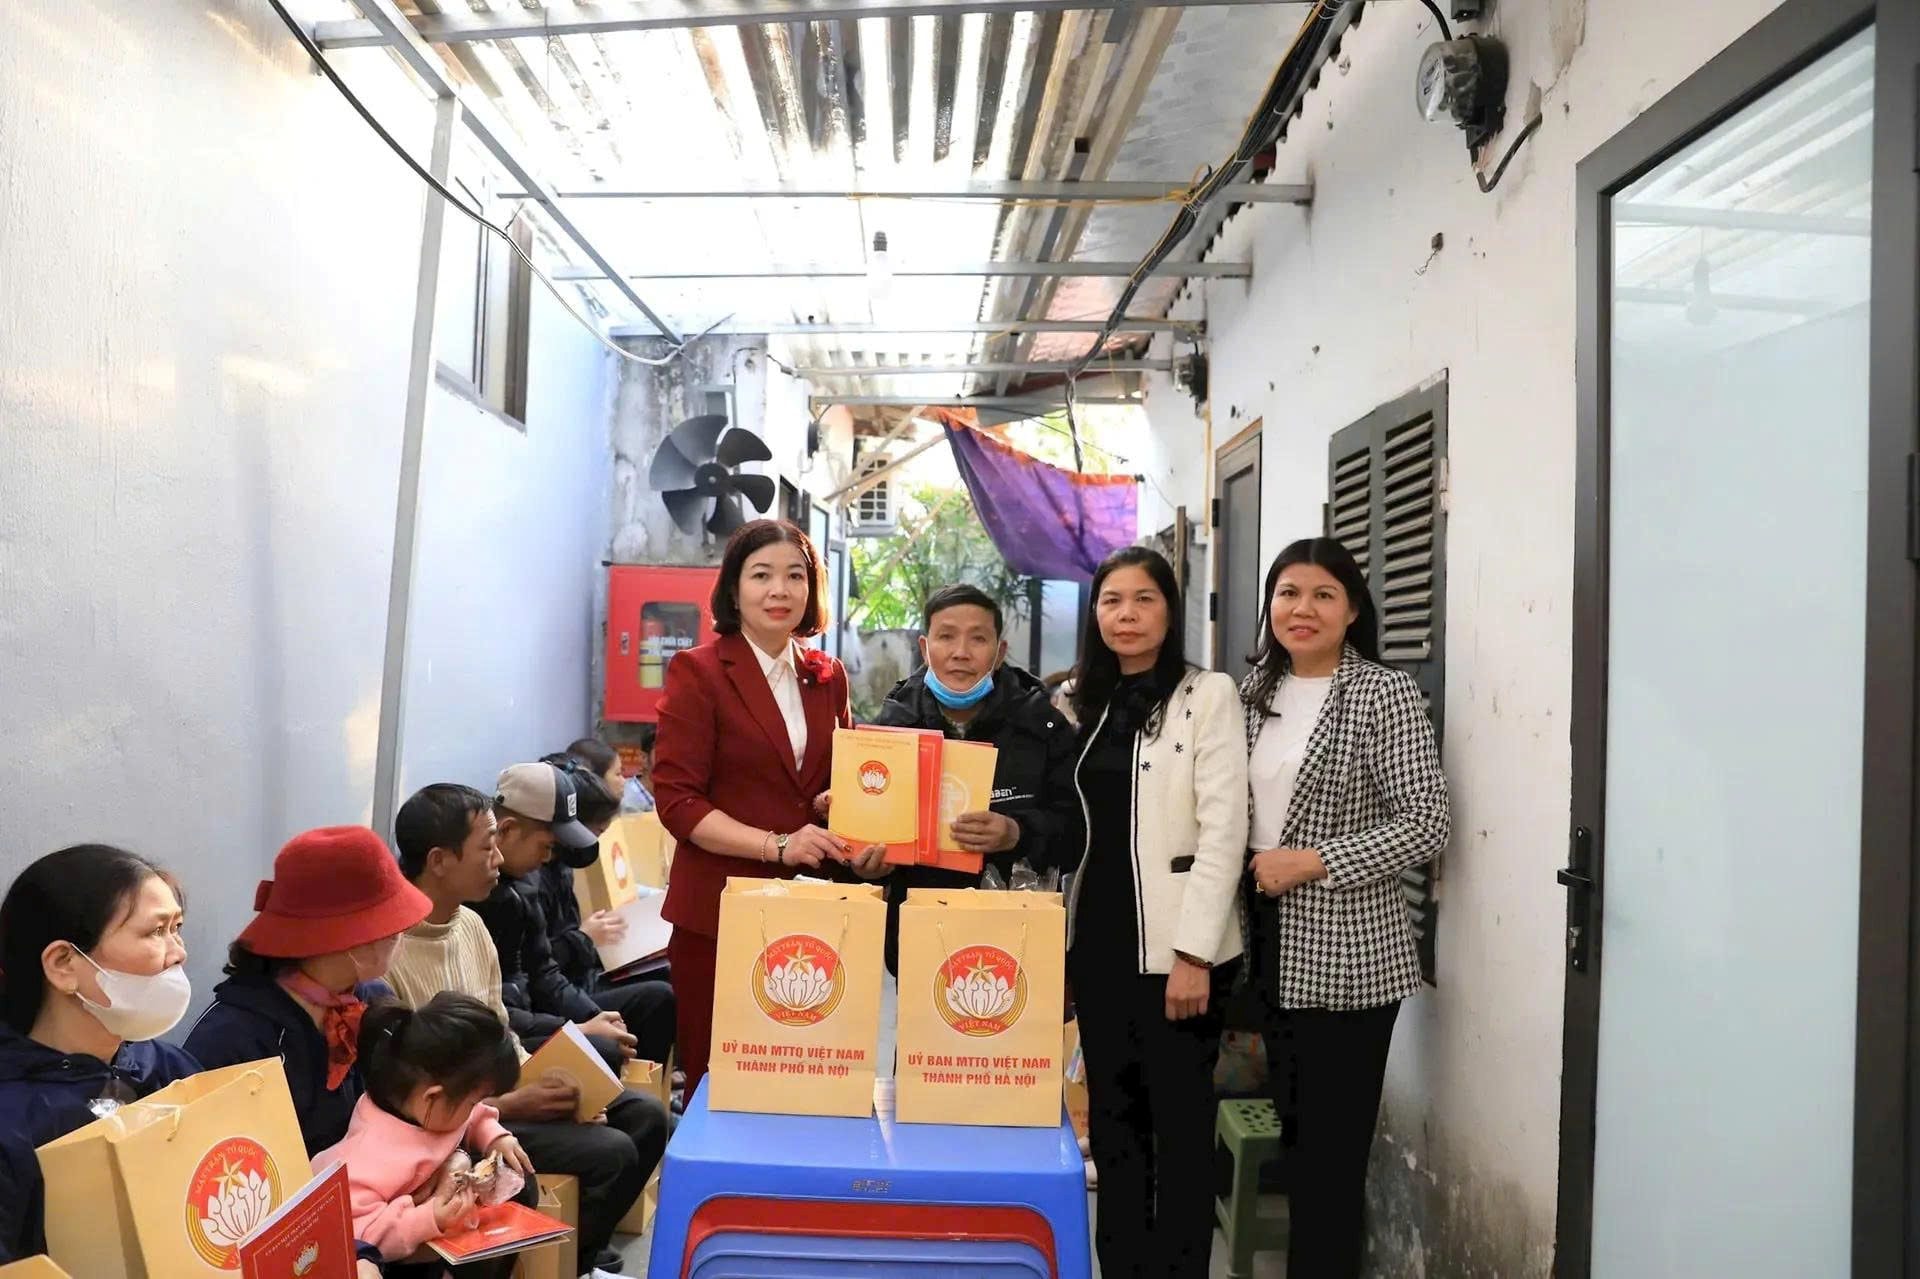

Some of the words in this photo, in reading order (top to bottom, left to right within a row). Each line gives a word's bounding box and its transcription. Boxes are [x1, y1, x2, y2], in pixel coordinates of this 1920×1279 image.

[742, 1043, 767, 1056] BAN
[771, 1045, 803, 1059] MTTQ
[807, 1045, 833, 1062] VIỆT
[836, 1049, 865, 1060] NAM
[735, 1058, 776, 1073] THÀNH
[780, 1059, 804, 1074] PHỐ
[808, 1061, 824, 1076] HÀ
[828, 1064, 849, 1079] NỘI
[927, 1055, 953, 1067] BAN
[956, 1056, 989, 1069] MTTQ
[993, 1055, 1018, 1070] VIỆT
[1022, 1057, 1051, 1069] NAM
[922, 1070, 963, 1084] THÀNH
[966, 1070, 991, 1085] PHỐ
[995, 1072, 1010, 1085] HÀ
[1015, 1073, 1036, 1088] NỘI
